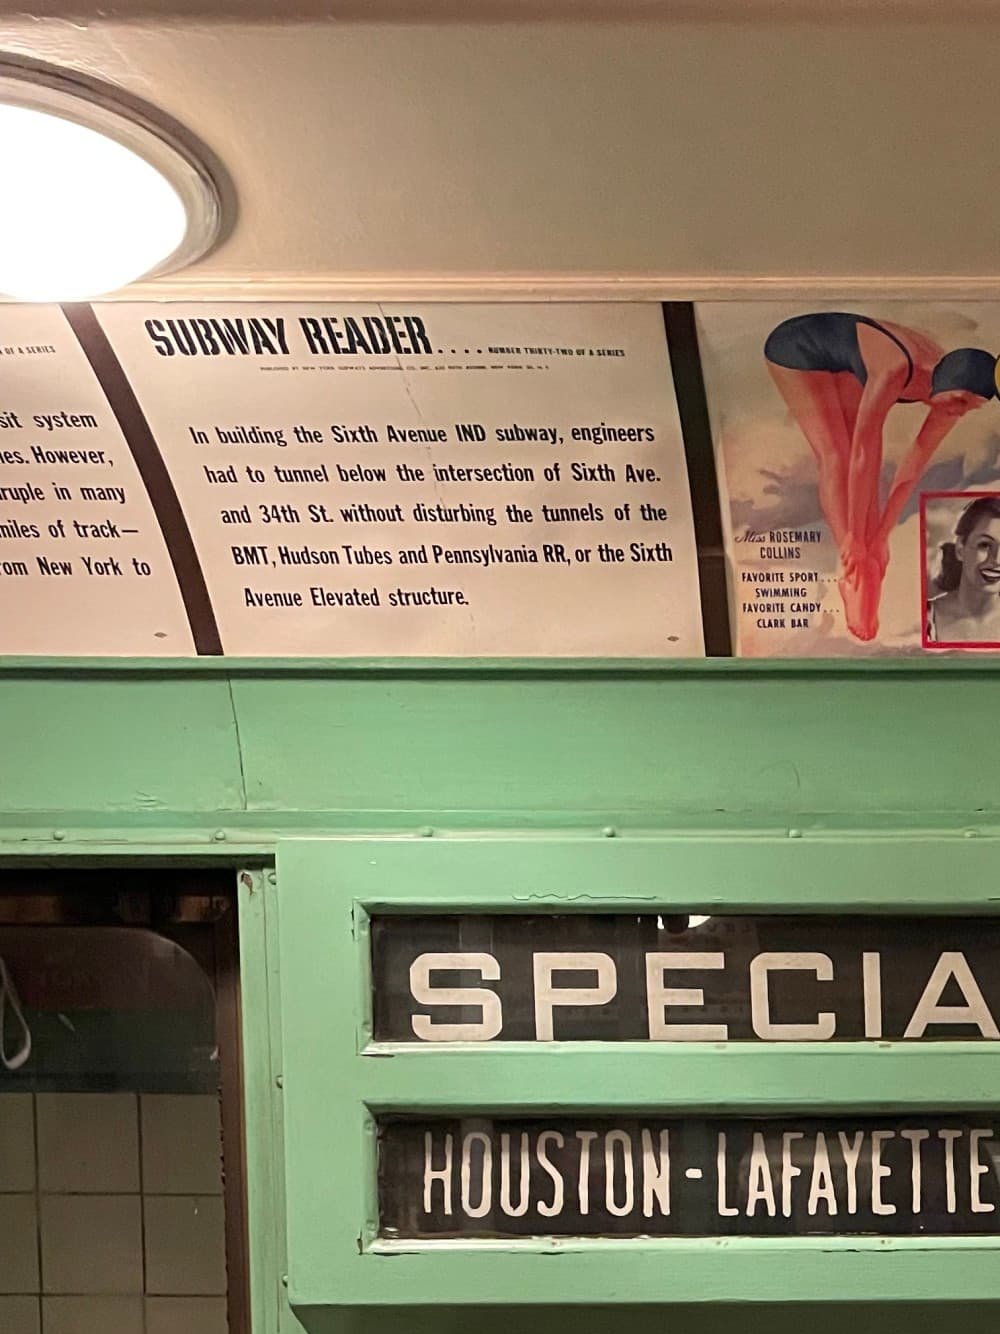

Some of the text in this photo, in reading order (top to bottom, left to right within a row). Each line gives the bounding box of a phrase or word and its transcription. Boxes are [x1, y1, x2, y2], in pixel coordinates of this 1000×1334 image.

[144, 317, 290, 357] SUBWAY
[596, 348, 625, 357] SERIES
[33, 411, 98, 432] system
[189, 423, 655, 447] In building the Sixth Avenue IND subway, engineers
[32, 446, 114, 467] However,
[203, 462, 662, 484] had to tunnel below the intersection of Sixth Ave.
[52, 482, 72, 501] in
[81, 486, 126, 504] many
[222, 502, 668, 526] and 34th St. without disturbing the tunnels of the
[48, 519, 66, 539] of
[735, 531, 822, 543] Miss ROSEMARY
[231, 542, 673, 569] BMT, Hudson Tubes and Pennsylvania RR, or the Sixth
[760, 547, 801, 559] COLLINS
[37, 556, 73, 577] New
[81, 556, 123, 577] York
[132, 557, 152, 577] to
[742, 572, 785, 582] FAVORITE
[243, 587, 470, 608] Avenue Elevated structure.
[755, 588, 807, 597] SWIMMING
[742, 603, 785, 613] FAVORITE
[756, 619, 809, 628] CLARK BAR
